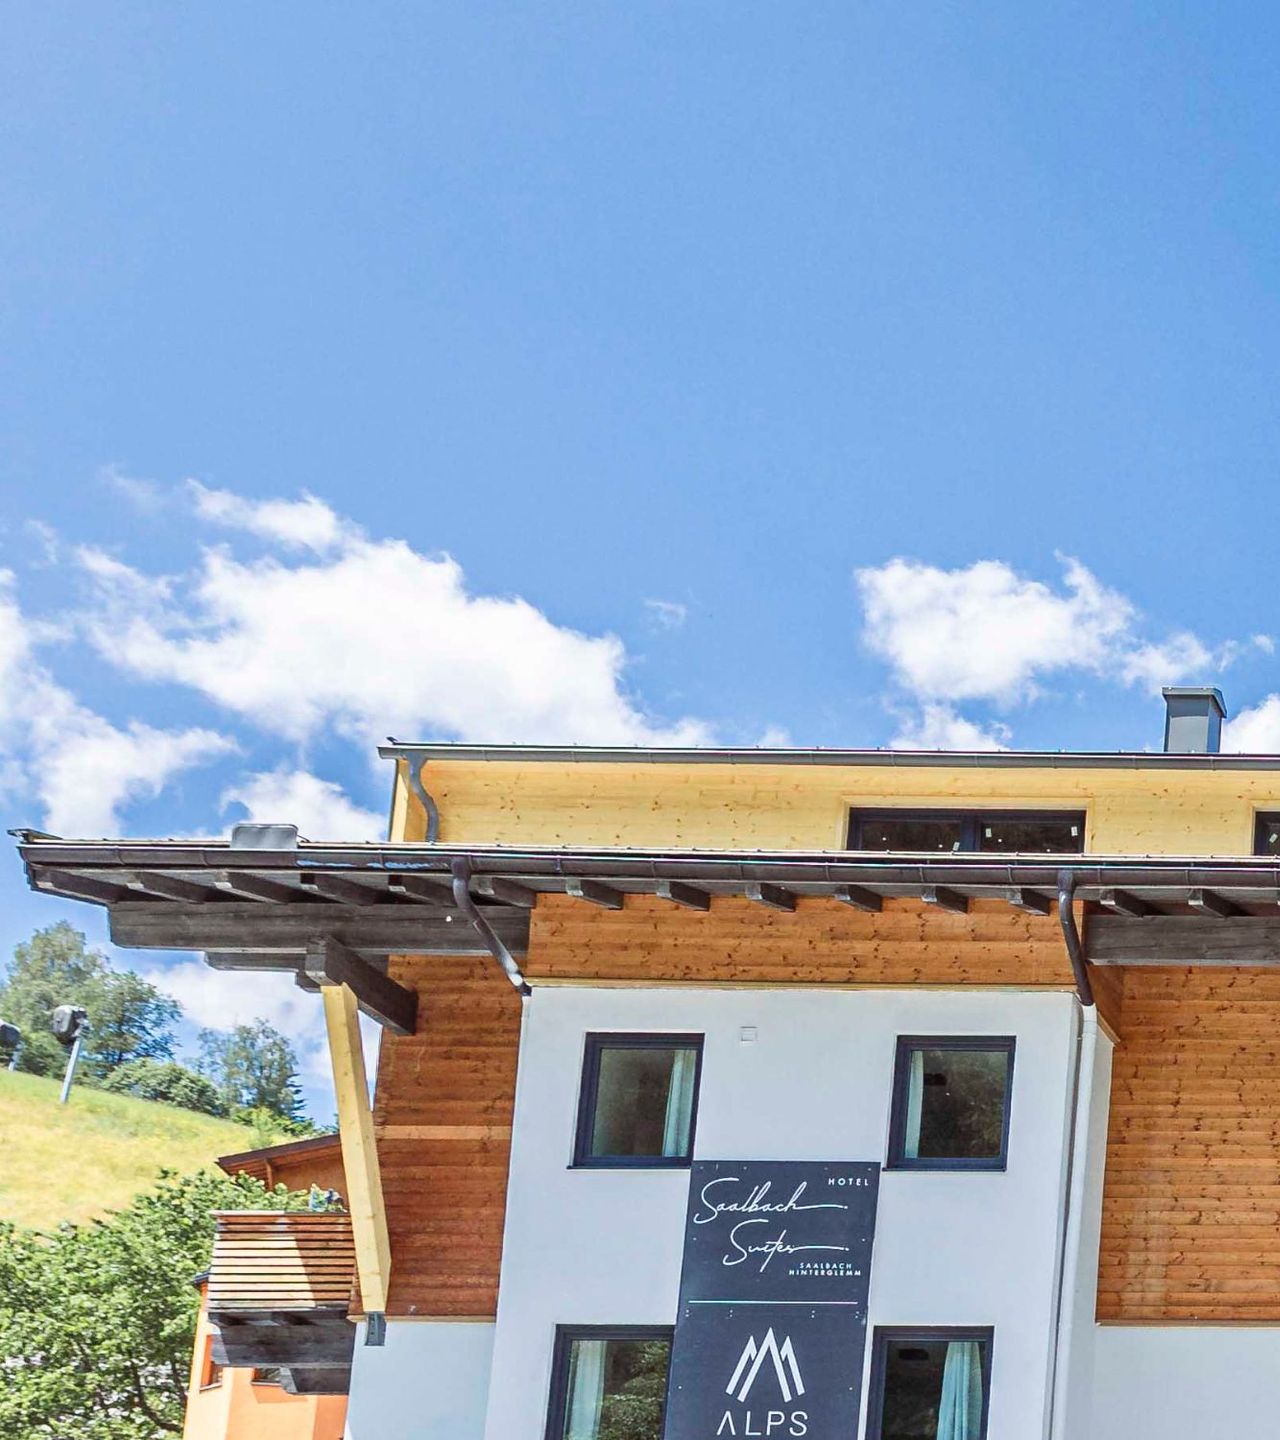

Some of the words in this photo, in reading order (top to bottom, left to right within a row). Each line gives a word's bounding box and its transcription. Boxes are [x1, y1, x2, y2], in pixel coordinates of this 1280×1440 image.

[828, 1177, 869, 1186] HOTEL
[693, 1177, 849, 1224] Saalbach
[722, 1218, 850, 1273] Suites
[788, 1269, 862, 1277] HINTERGLEMM
[799, 1262, 853, 1270] SAALBACH
[716, 1410, 808, 1437] ALPS
